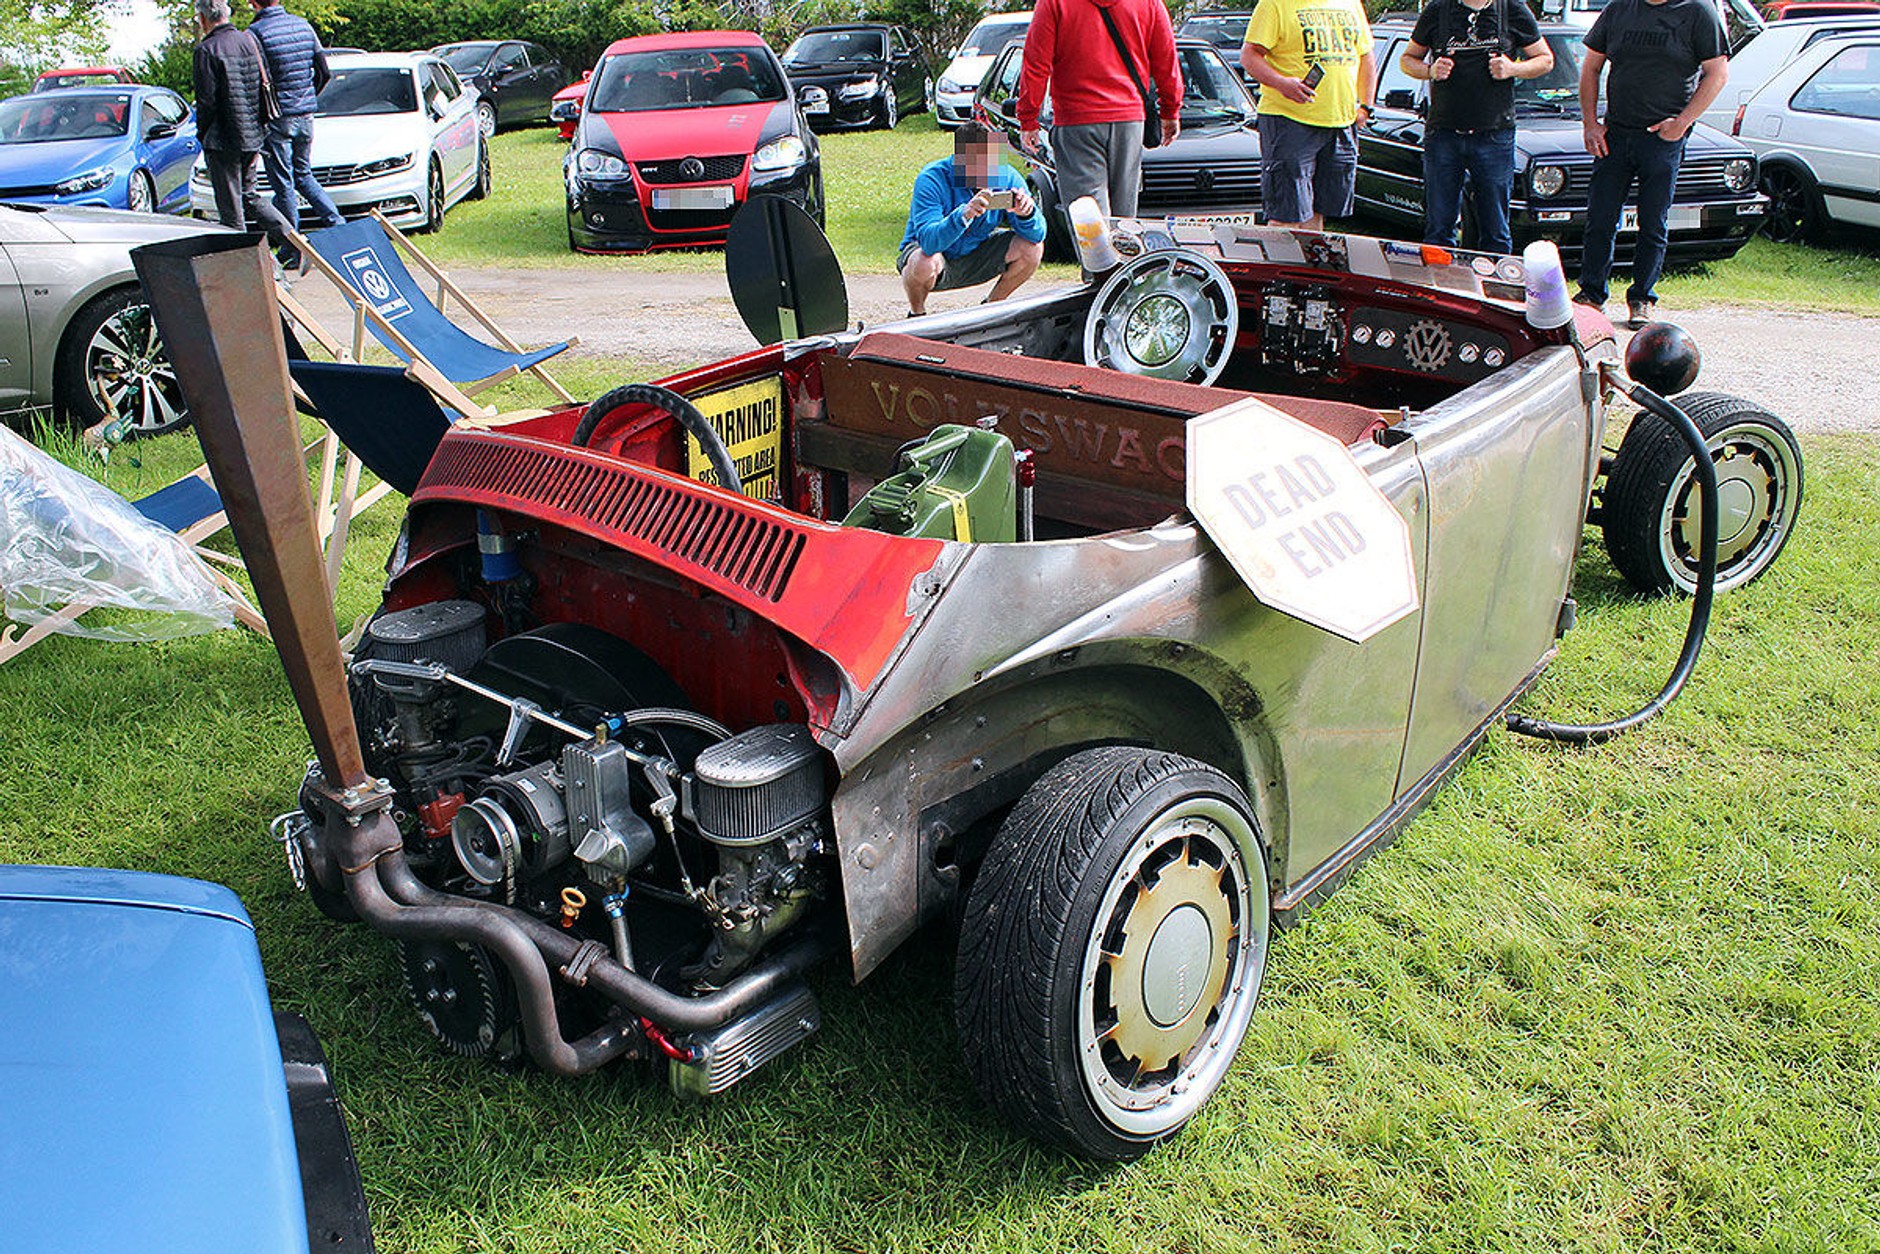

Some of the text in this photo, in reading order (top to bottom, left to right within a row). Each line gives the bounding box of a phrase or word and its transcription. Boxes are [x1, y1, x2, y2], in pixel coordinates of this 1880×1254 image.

[1622, 29, 1670, 47] PUMA
[706, 396, 777, 448] ARNING!
[1222, 455, 1336, 531] DEAD
[1277, 511, 1367, 580] END
